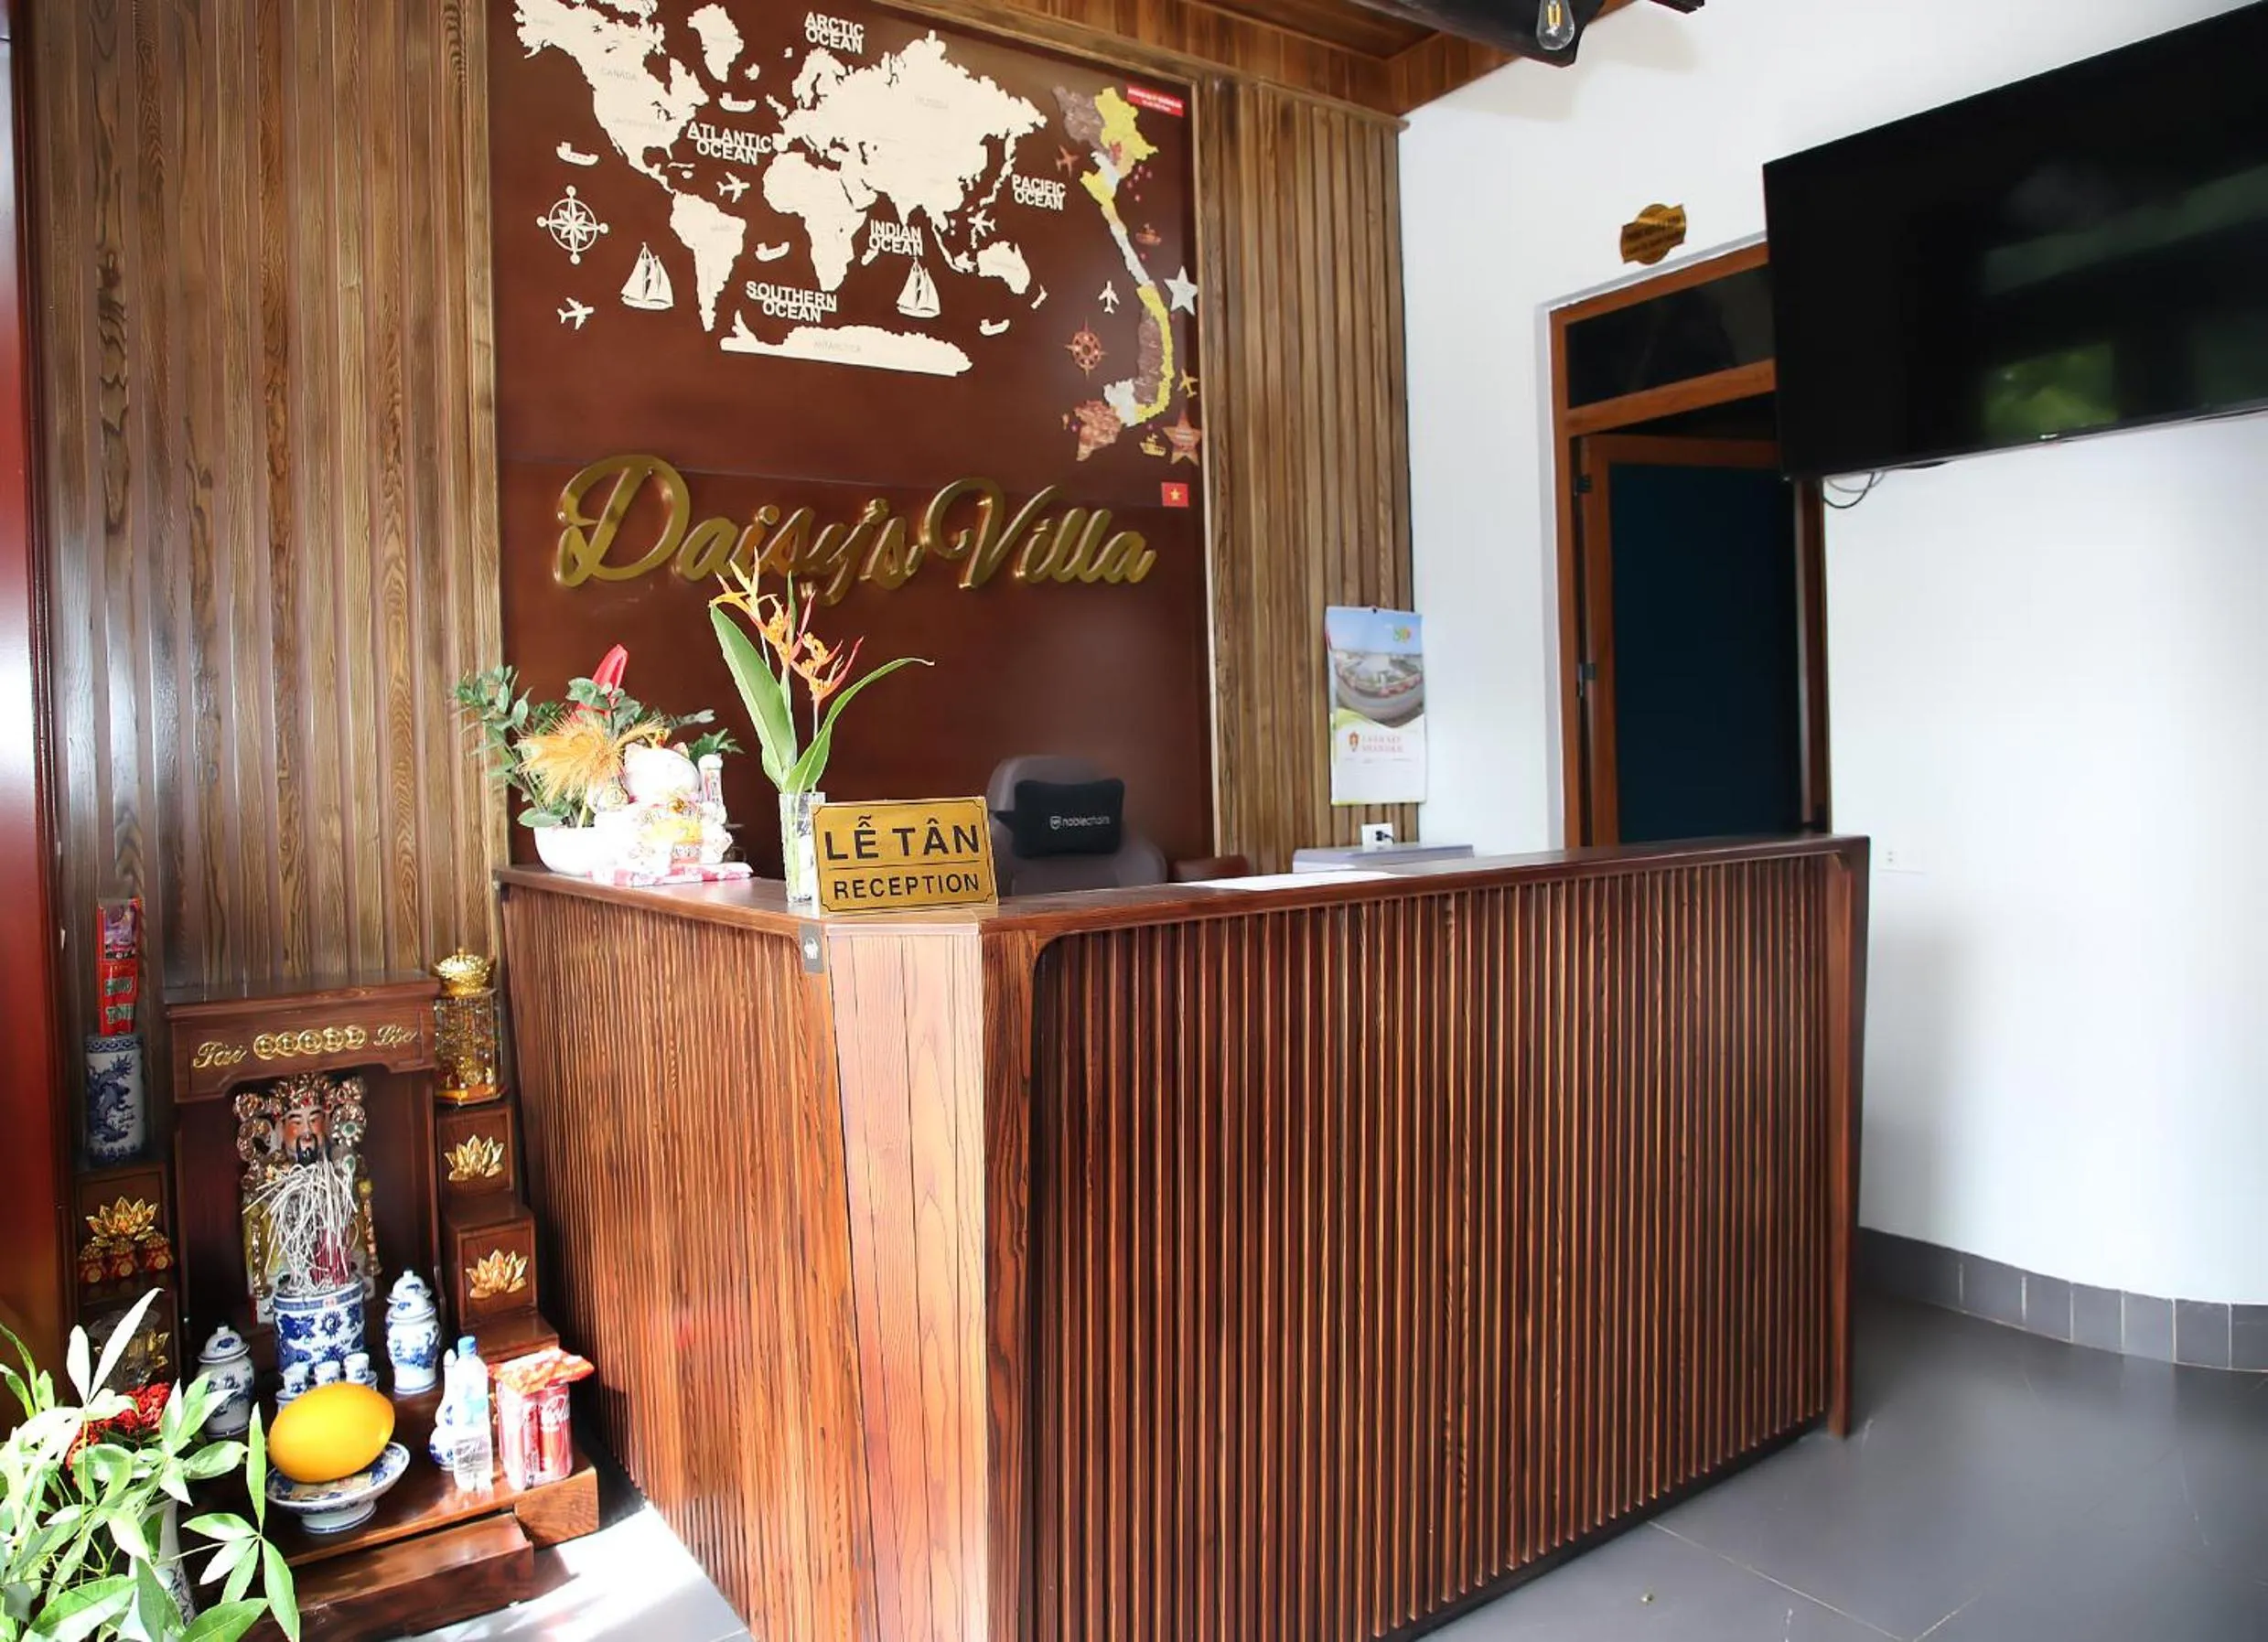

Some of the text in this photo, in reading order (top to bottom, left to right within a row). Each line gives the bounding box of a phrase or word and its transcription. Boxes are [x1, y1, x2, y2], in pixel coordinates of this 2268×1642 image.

[805, 12, 864, 38] ARCTIC
[805, 29, 864, 55] OCEAN
[687, 121, 773, 153] ATLANTIC
[696, 139, 758, 166] OCEAN
[1011, 174, 1067, 198] PACIFIC
[1014, 189, 1064, 211] OCEAN
[869, 219, 922, 242] INDIAN
[868, 235, 924, 257] OCEAN
[746, 281, 837, 313] SOUTHERN
[762, 300, 822, 324] OCEAN
[553, 453, 1157, 607] Daisy's Villa
[824, 814, 980, 861] LỄ TÂN
[833, 873, 980, 901] RECEPTION
